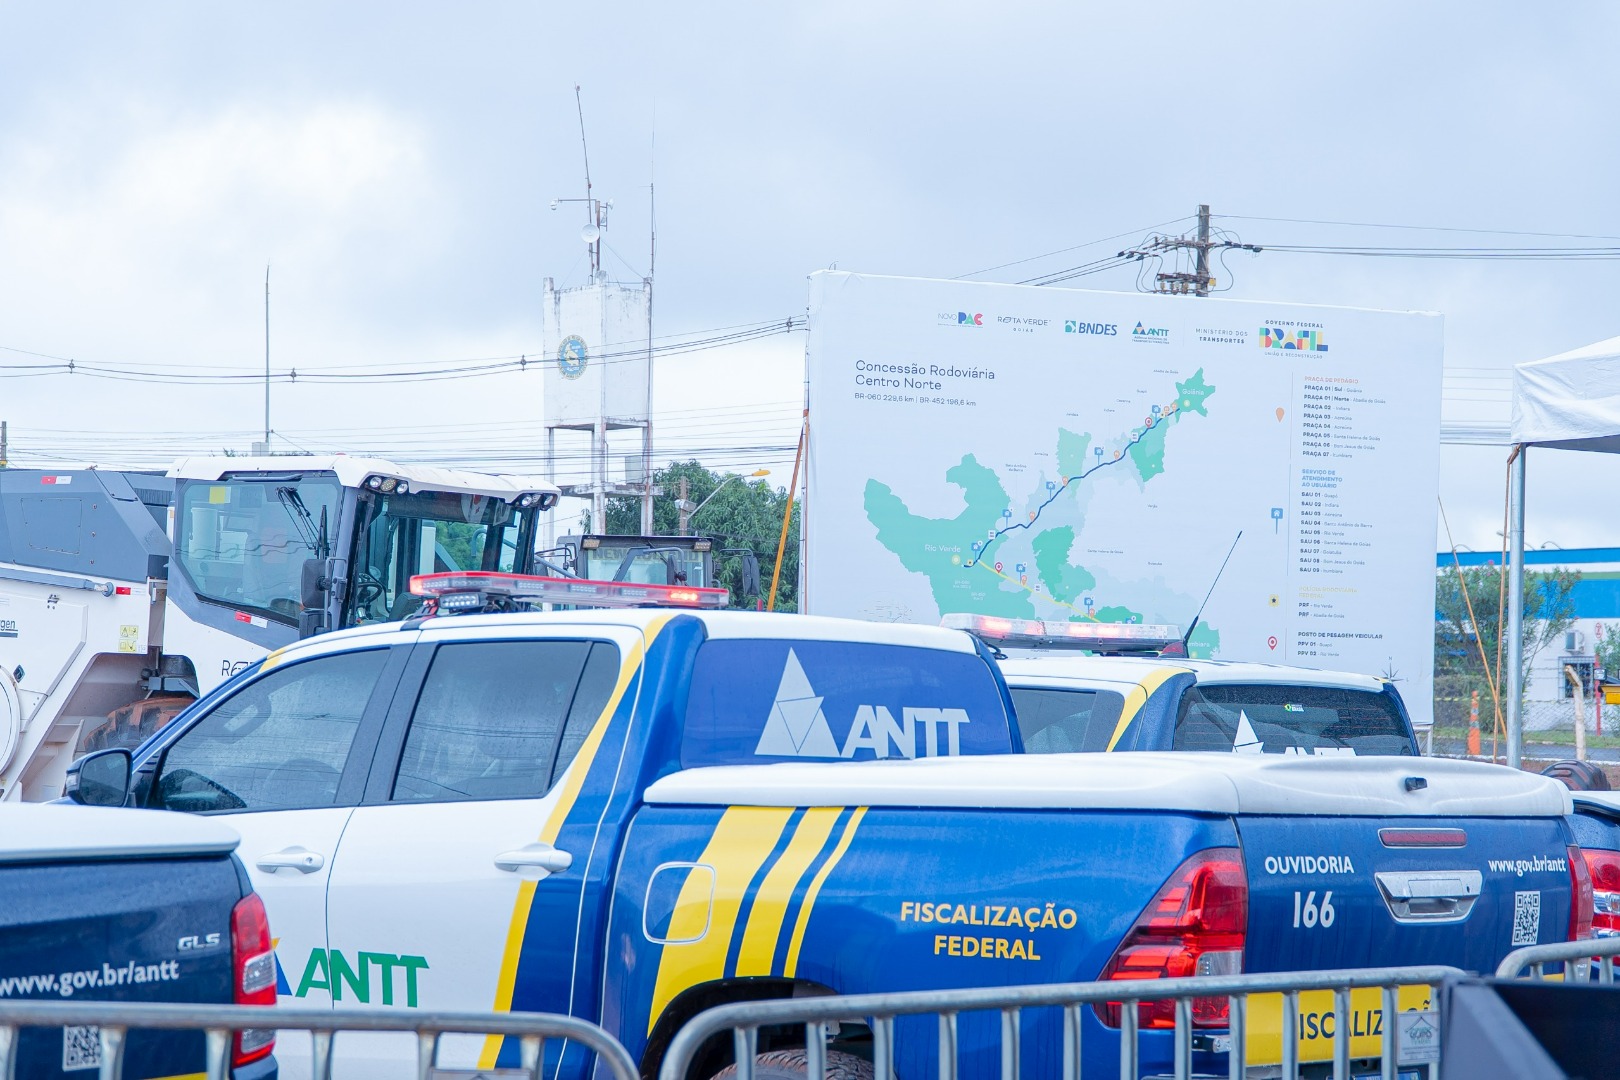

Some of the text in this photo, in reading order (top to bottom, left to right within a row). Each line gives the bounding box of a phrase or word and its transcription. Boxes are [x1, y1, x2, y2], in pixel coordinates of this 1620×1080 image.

[938, 312, 983, 326] NOVO PAC
[1078, 322, 1117, 336] BNDES
[1146, 328, 1170, 336] ANTT
[1199, 336, 1245, 344] TRANSPORTES
[1259, 328, 1328, 352] BRASIL
[856, 360, 996, 380] Concessão Rodoviária
[855, 374, 942, 390] Centro Norte
[840, 704, 970, 760] ANTT
[1264, 856, 1354, 874] OUVIDORIA
[1488, 855, 1567, 877] www.gov.br/antt
[900, 902, 1078, 932] FISCALIZAÇÃO
[1293, 890, 1335, 928] 166
[177, 933, 220, 952] GLS
[934, 934, 1041, 960] FEDERAL
[0, 960, 180, 997] www.gov.br/antt
[294, 946, 430, 1008] ANTT
